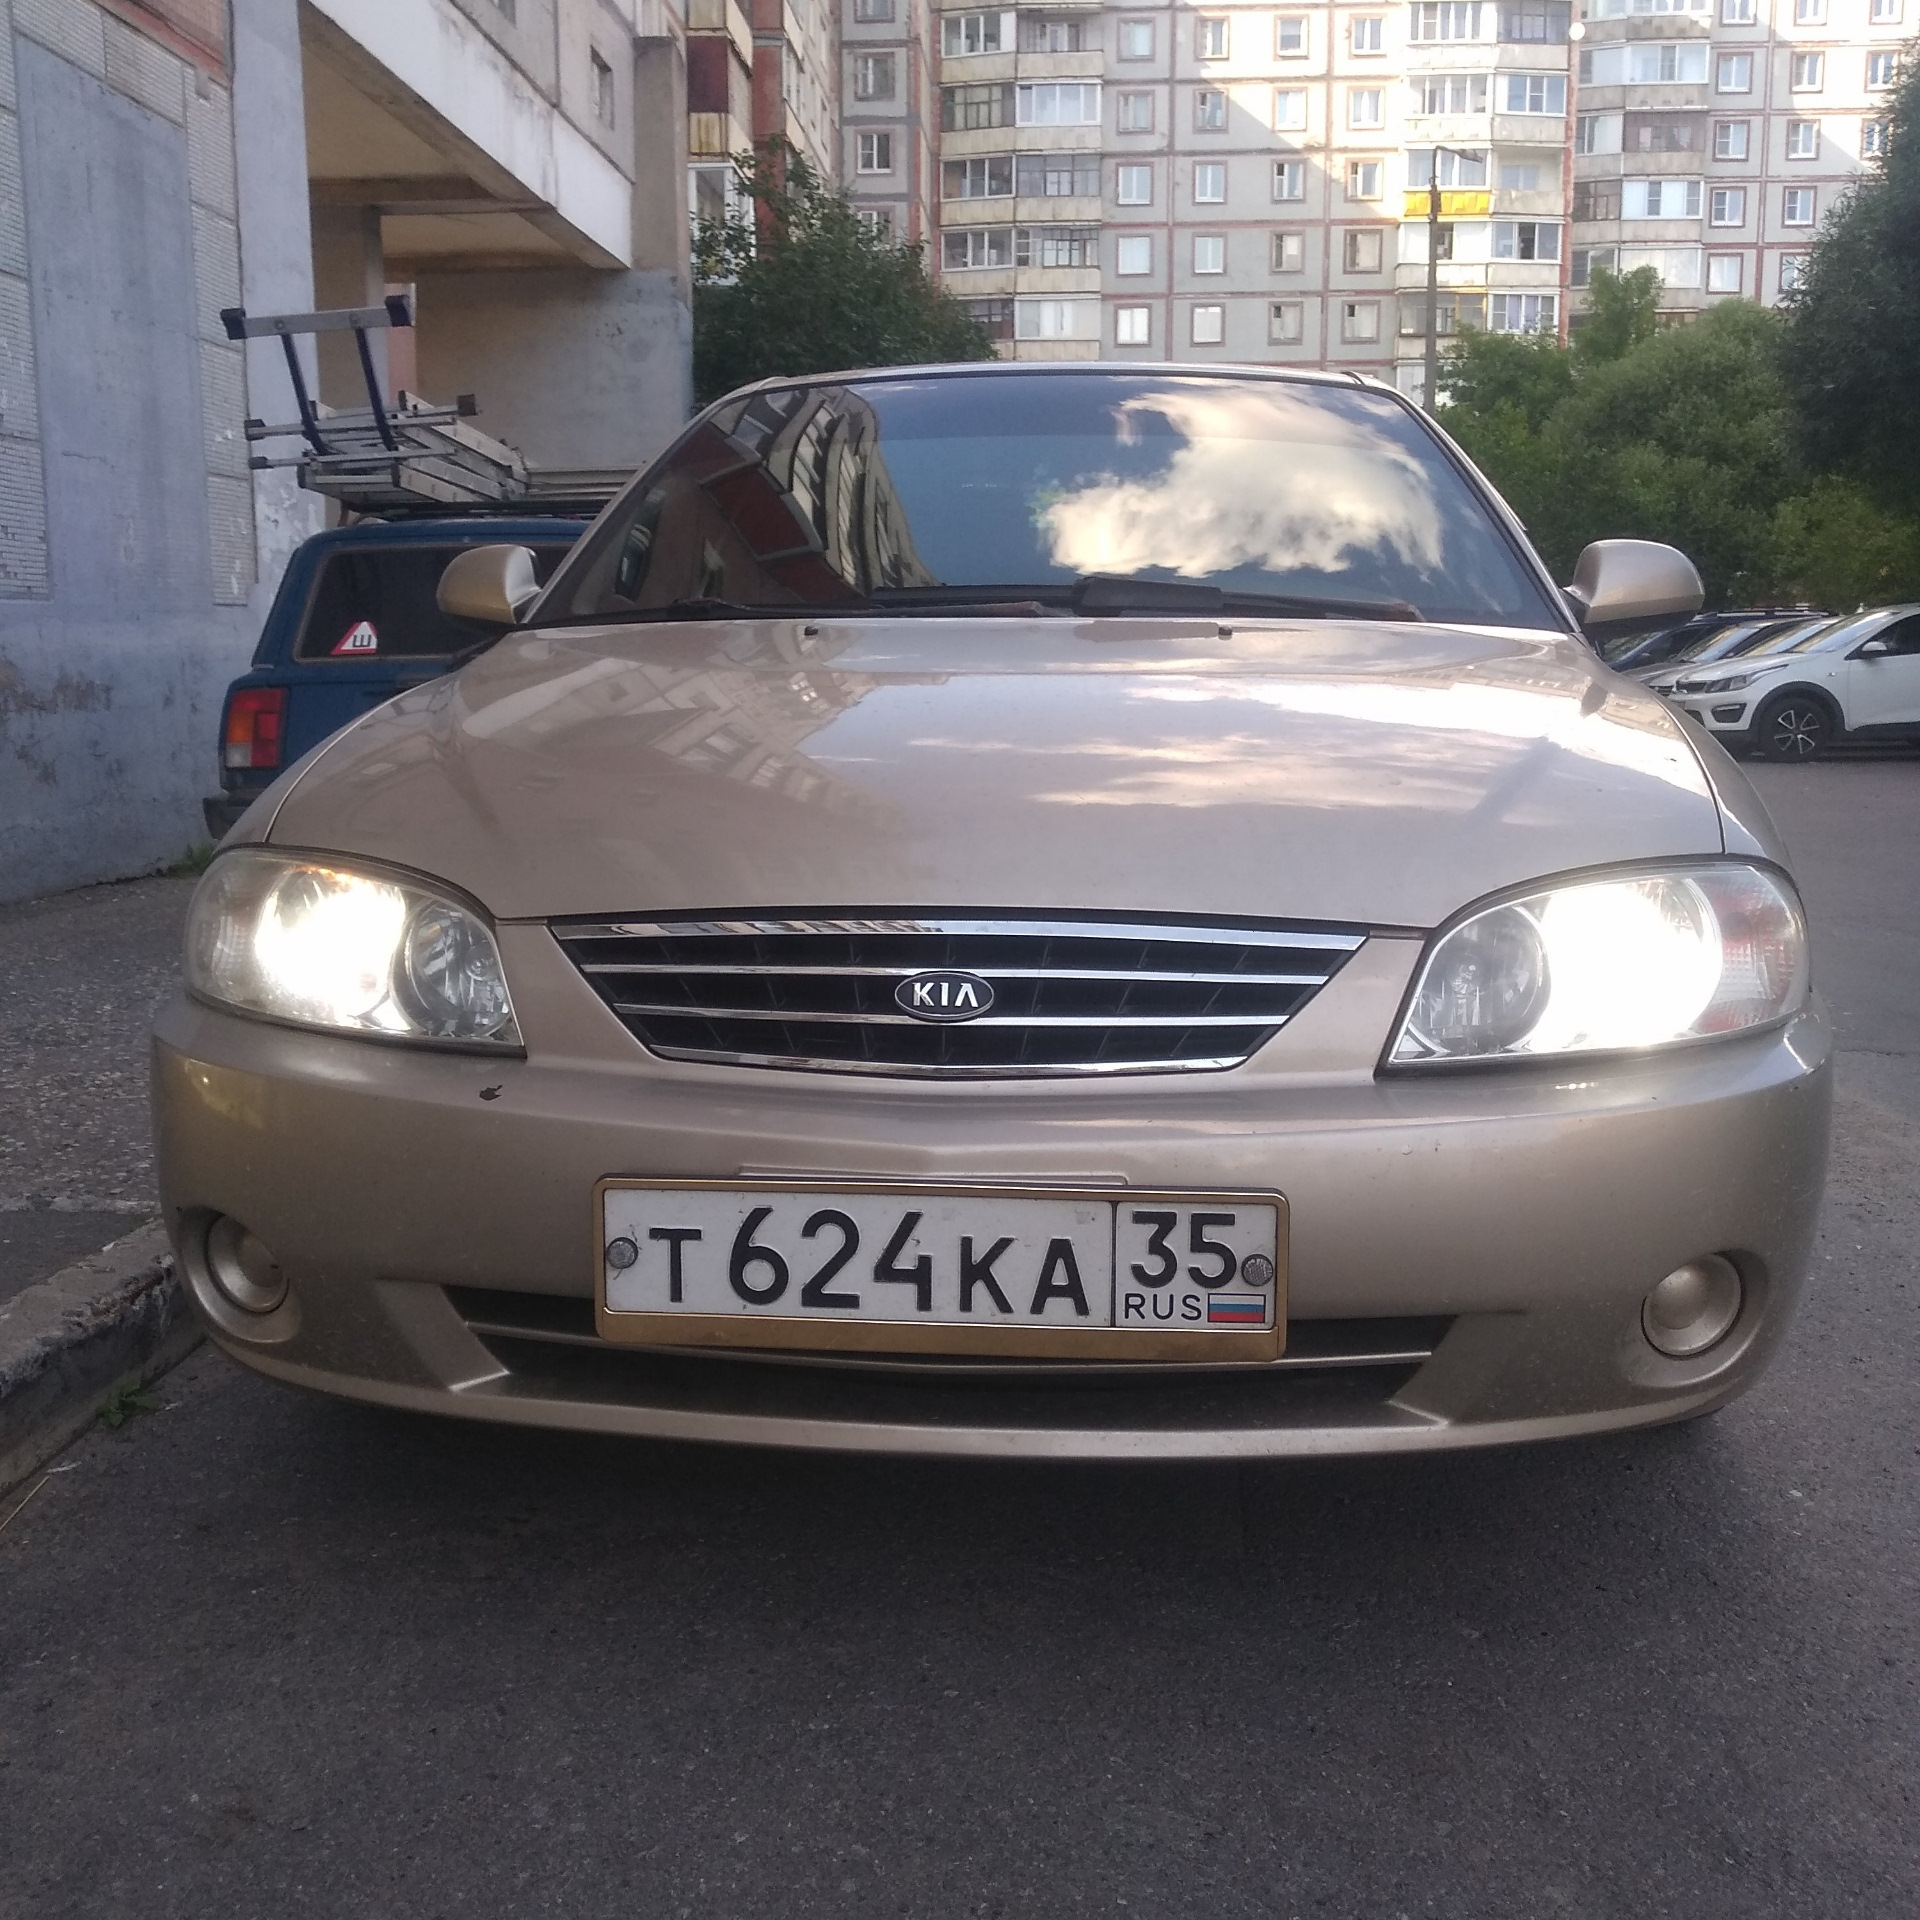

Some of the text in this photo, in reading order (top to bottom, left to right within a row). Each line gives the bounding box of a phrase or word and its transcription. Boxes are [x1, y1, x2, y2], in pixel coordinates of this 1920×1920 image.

[912, 982, 979, 1007] KIA
[1130, 1210, 1237, 1290] 35
[1124, 1293, 1203, 1321] RUS
